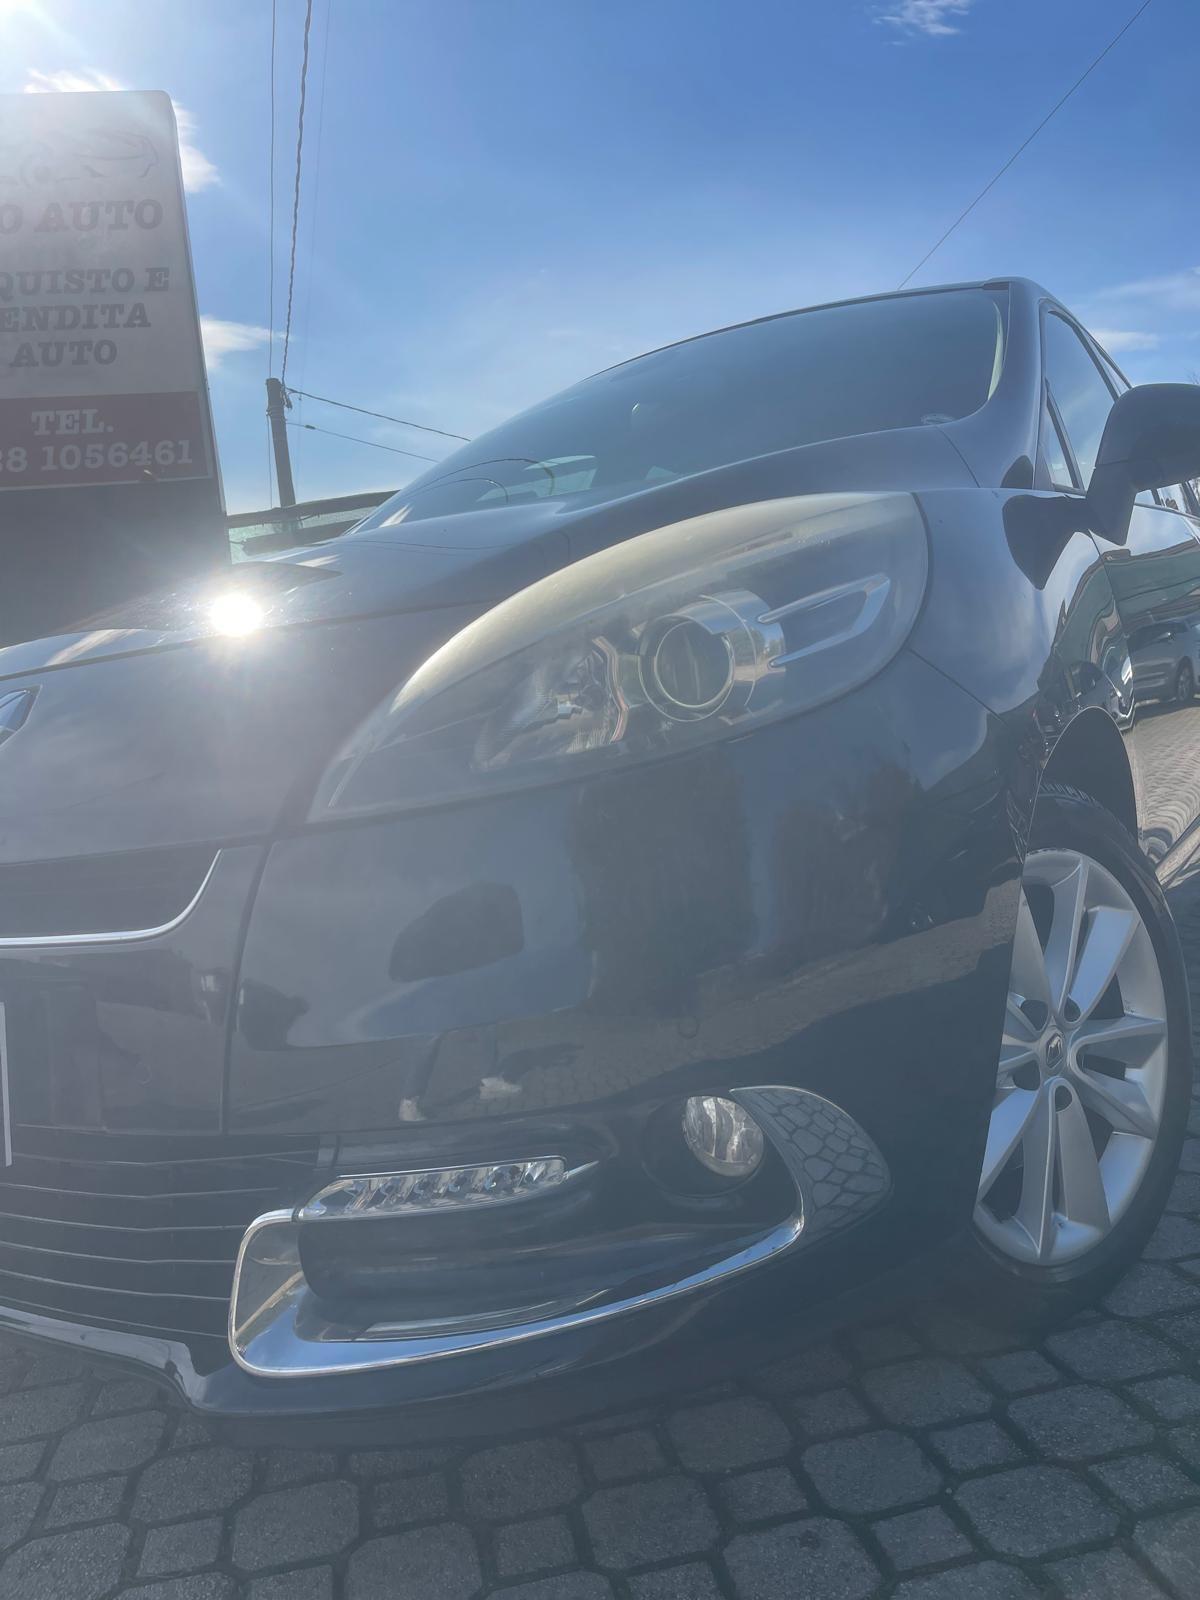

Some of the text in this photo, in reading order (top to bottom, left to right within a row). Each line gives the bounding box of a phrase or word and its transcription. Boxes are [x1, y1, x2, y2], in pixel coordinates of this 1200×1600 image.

[0, 199, 163, 234] O AUTO
[144, 267, 170, 291] E
[0, 303, 151, 332] ENDITA
[9, 340, 118, 367] AUTO
[31, 409, 114, 435] TEL.
[0, 440, 192, 473] 8 1056461
